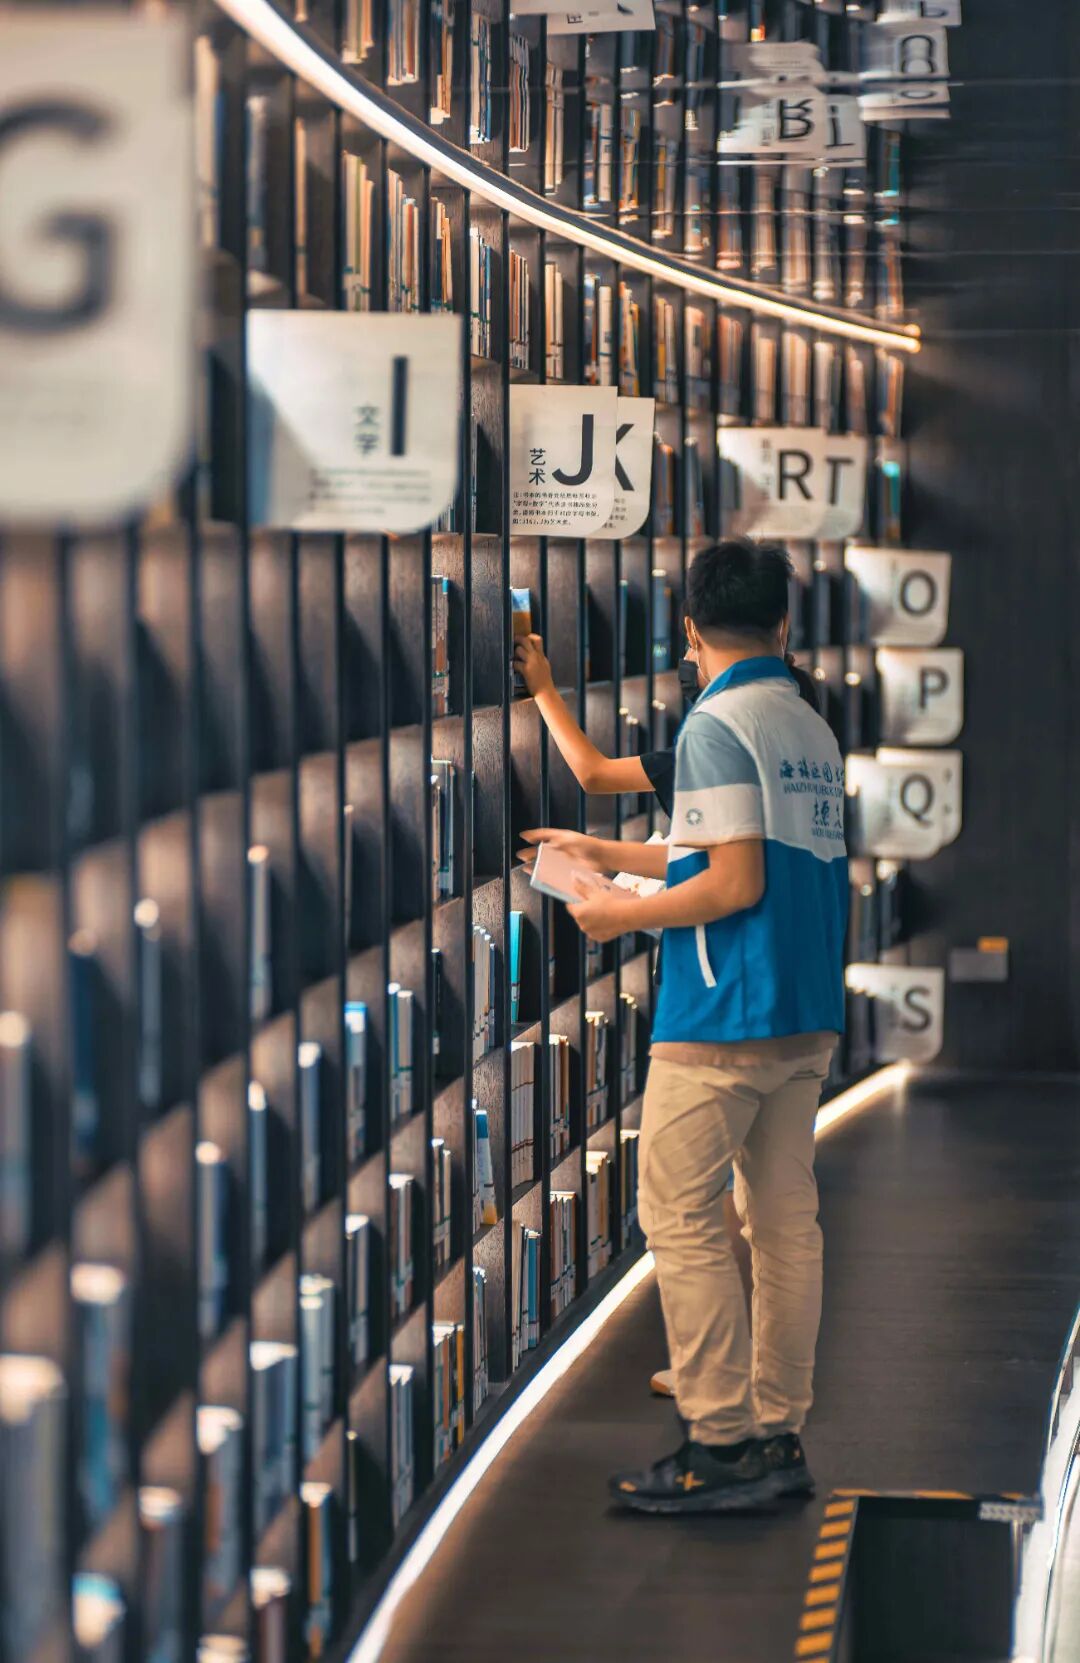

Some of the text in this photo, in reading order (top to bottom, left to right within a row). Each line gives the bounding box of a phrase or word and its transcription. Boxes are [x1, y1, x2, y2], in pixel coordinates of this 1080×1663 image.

[0, 93, 116, 341] G
[391, 355, 408, 456] I
[528, 448, 546, 486] 艺术
[552, 414, 594, 486] J
[778, 449, 814, 501] R
[825, 456, 854, 507] T
[900, 569, 938, 617] O
[919, 666, 949, 710] P
[900, 773, 934, 828] Q
[903, 986, 933, 1032] S
